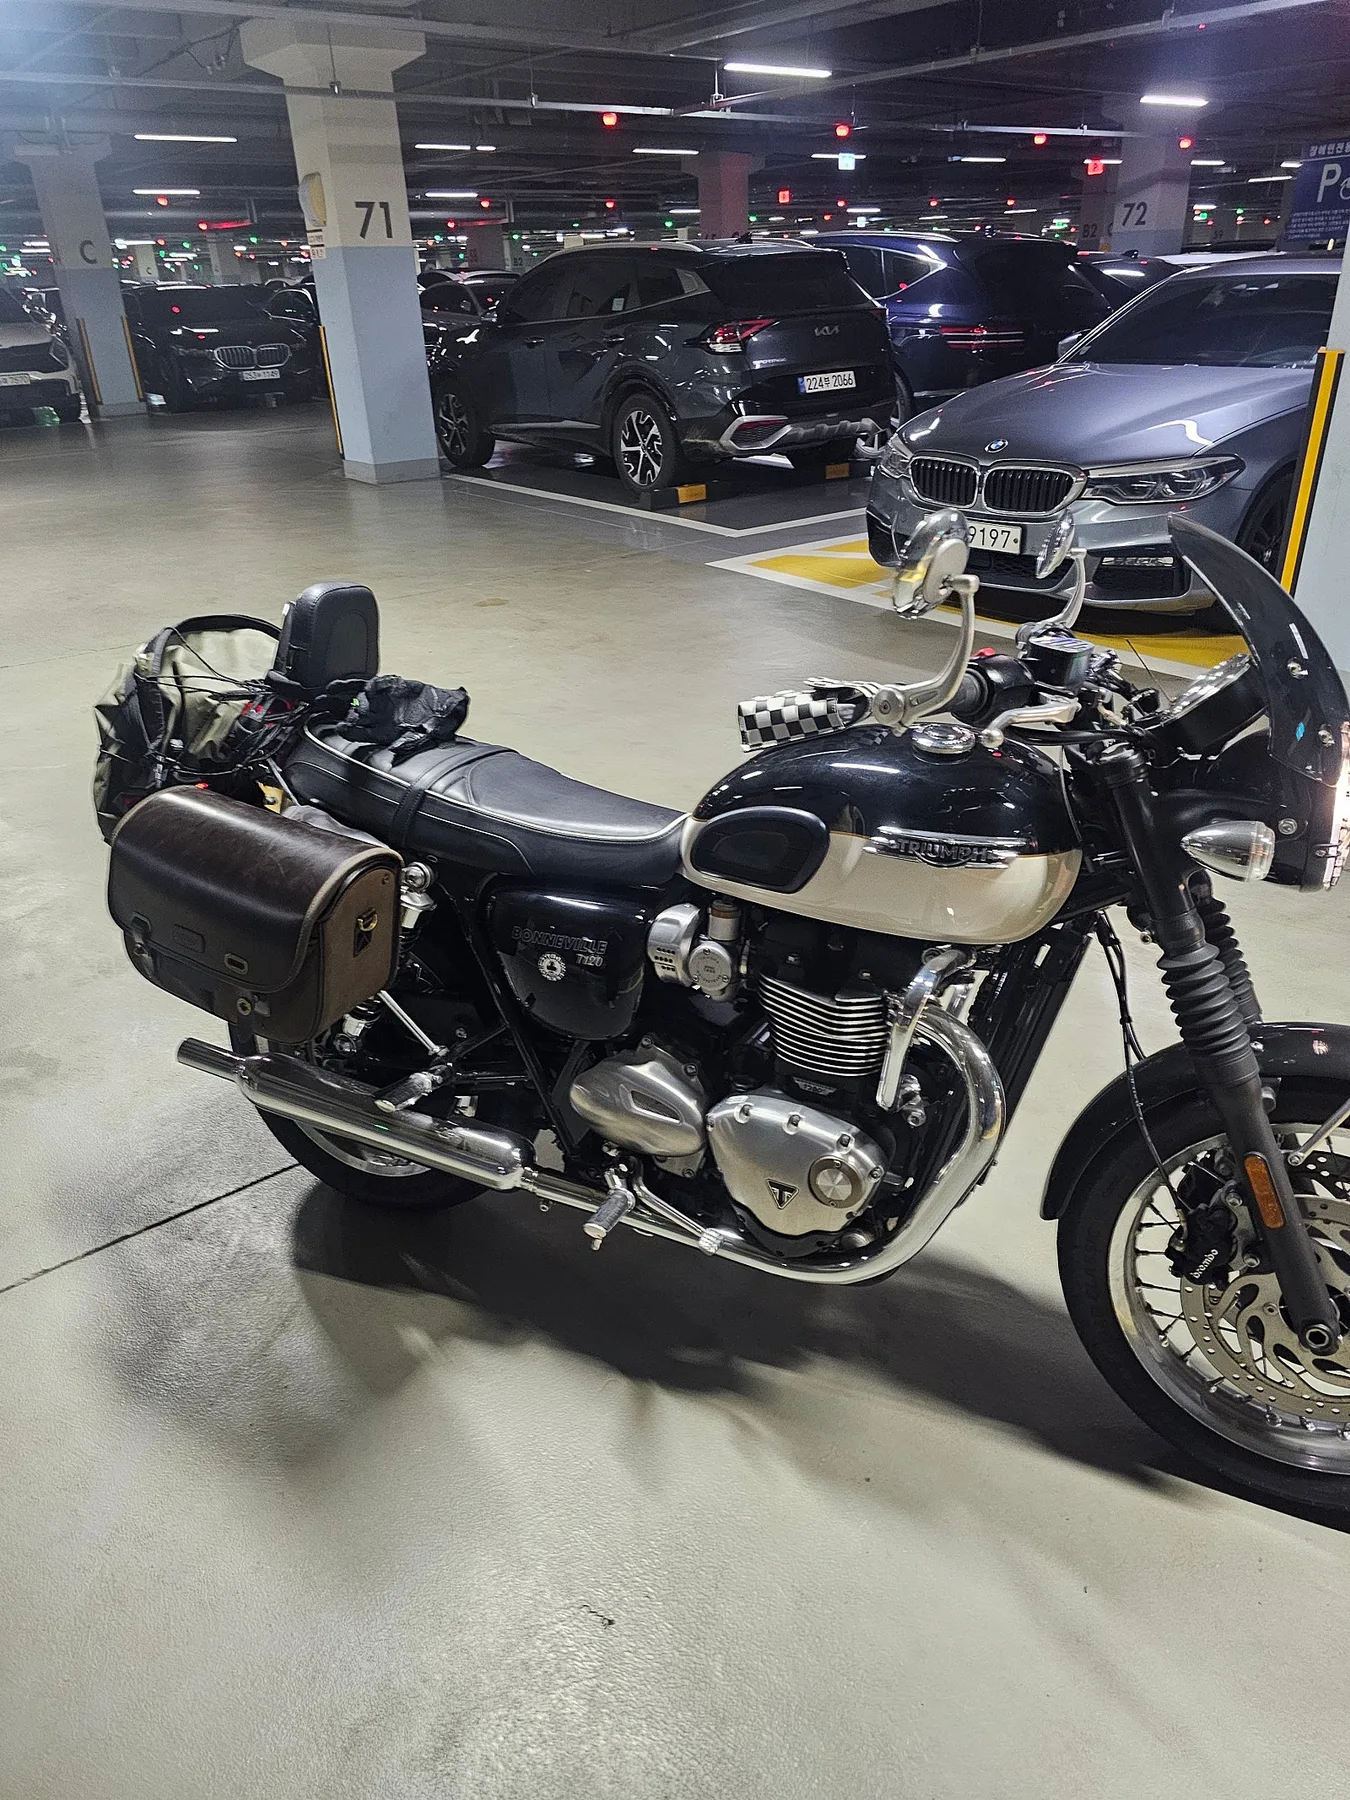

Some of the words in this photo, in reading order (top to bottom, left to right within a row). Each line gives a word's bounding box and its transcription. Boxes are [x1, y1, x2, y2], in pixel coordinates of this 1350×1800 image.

[1317, 163, 1342, 203] P
[355, 201, 393, 239] 71
[1122, 201, 1148, 226] 72
[1082, 223, 1098, 238] B2
[79, 239, 98, 265] C
[832, 374, 854, 387] 2066
[968, 526, 1011, 549] 9197
[897, 838, 988, 862] TRIUMPH
[512, 925, 608, 955] BONNEVILLE
[576, 953, 604, 967] T120
[1189, 1249, 1219, 1279] brembo
